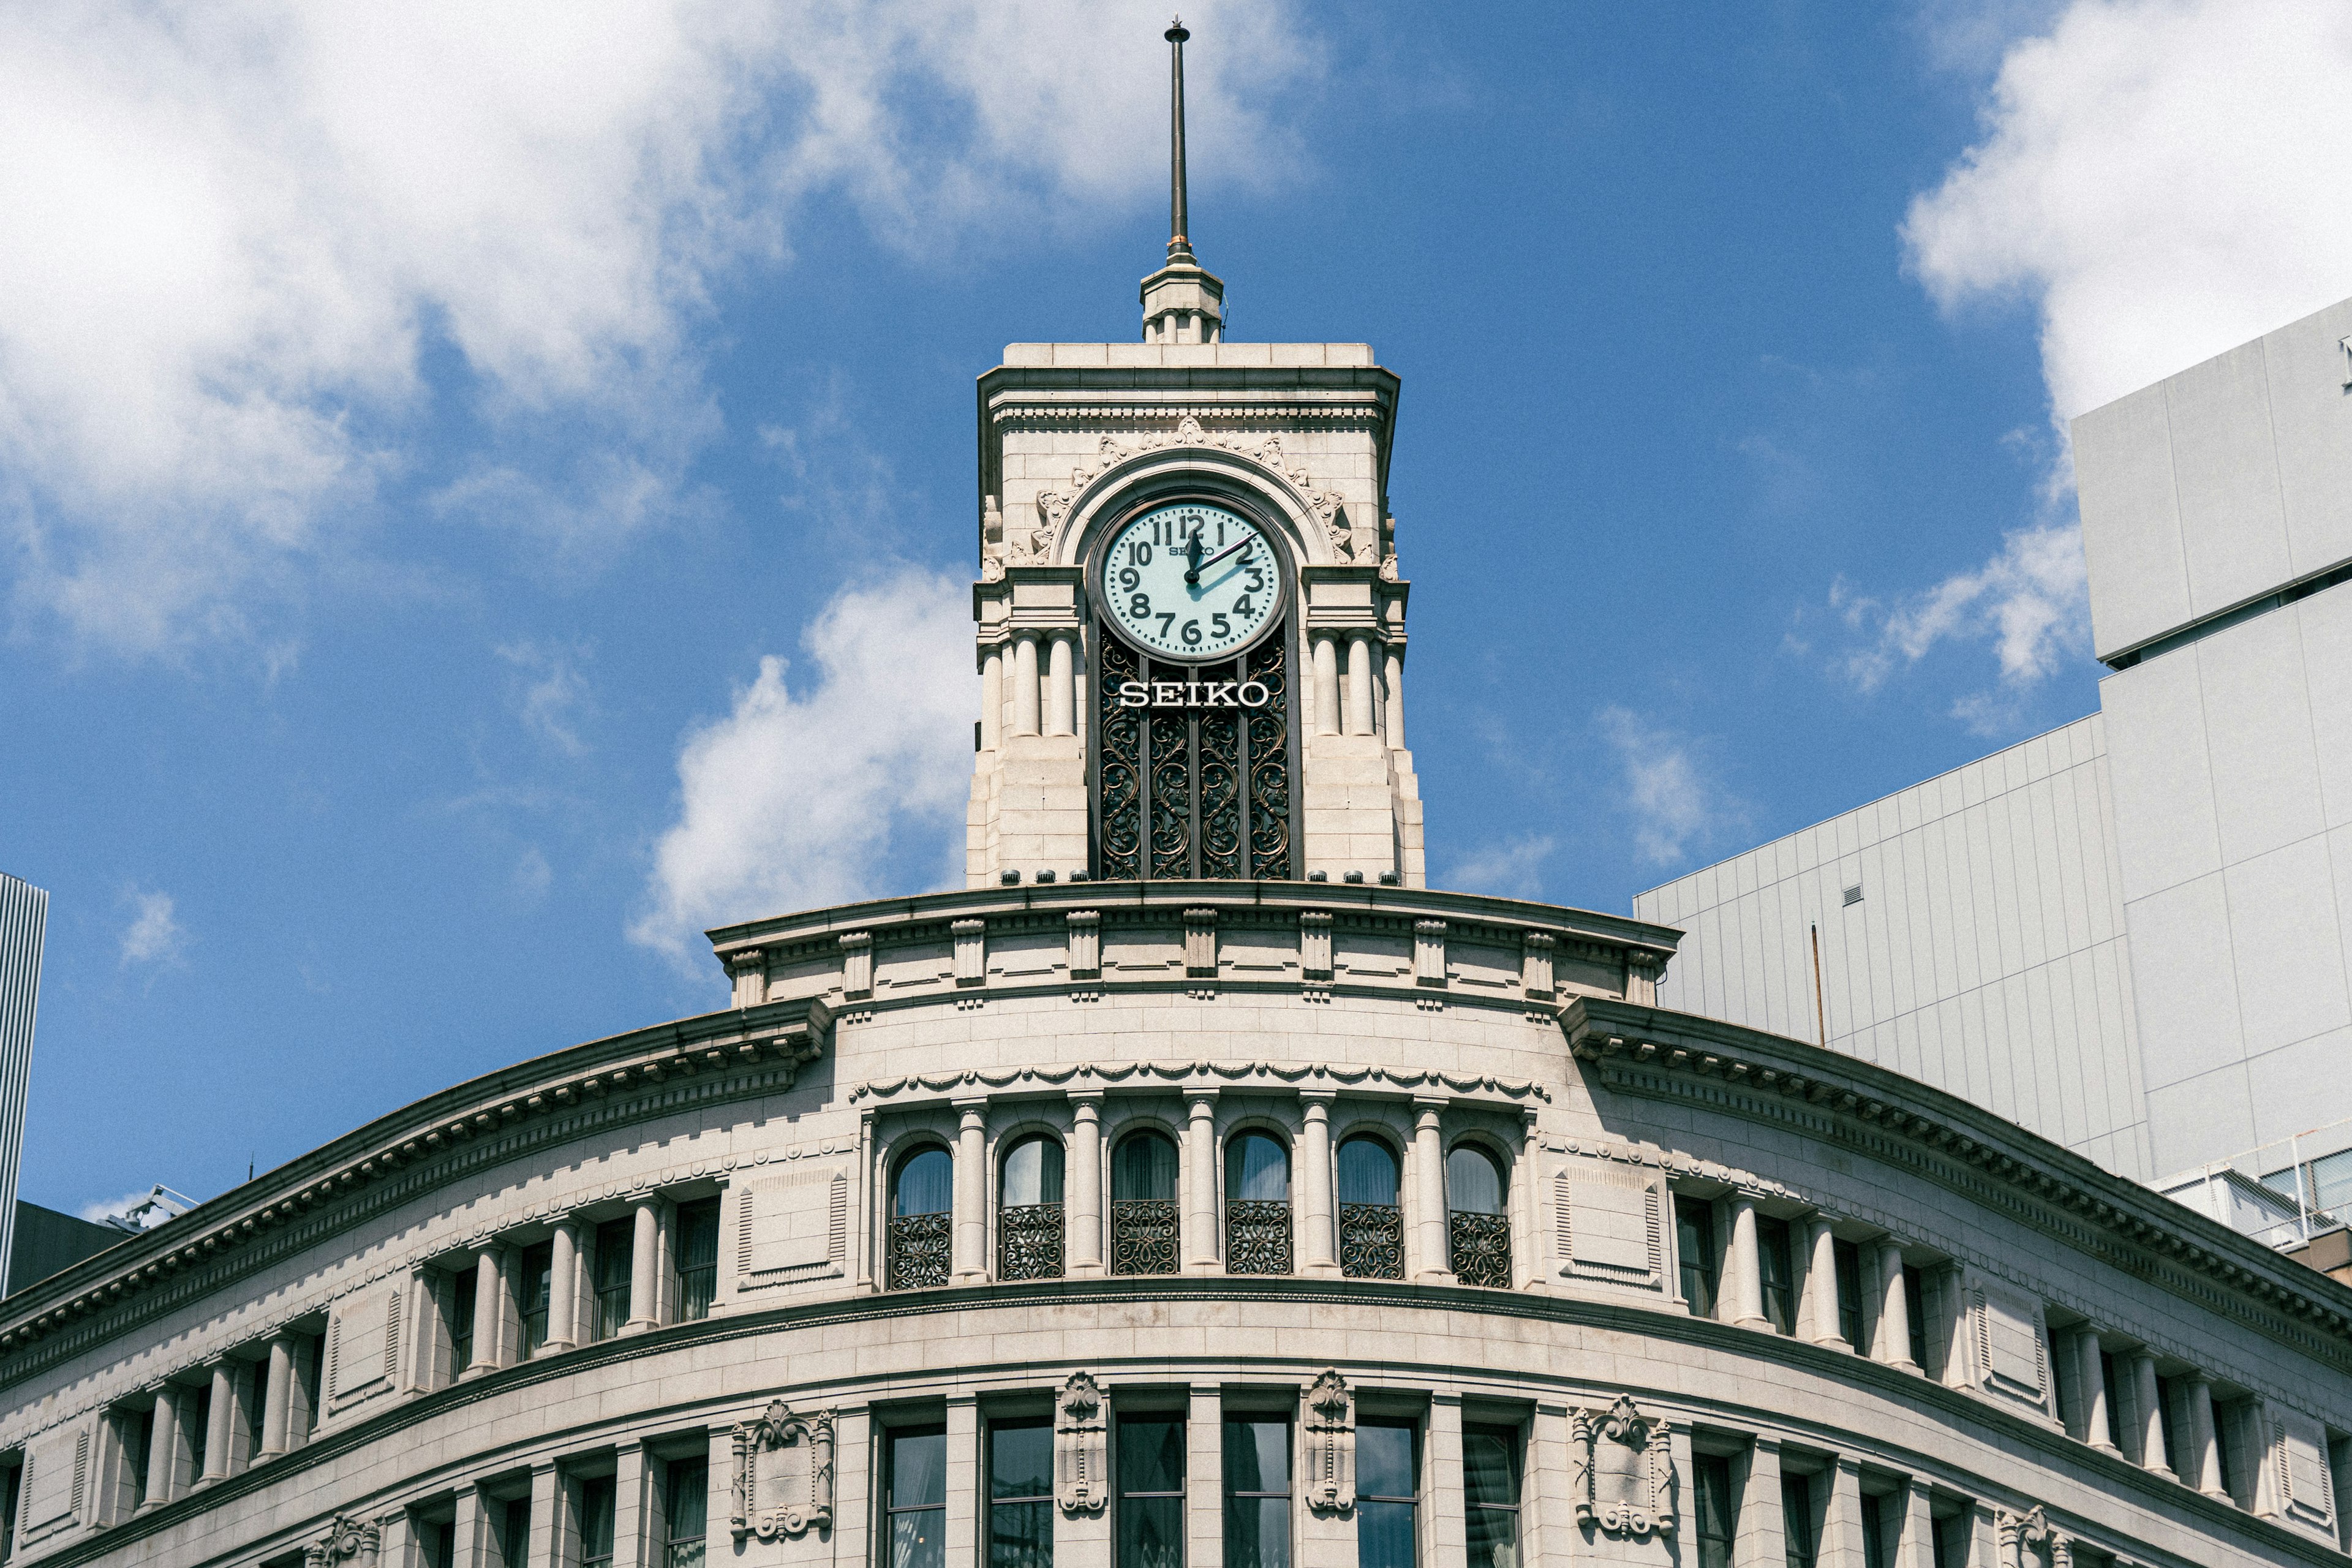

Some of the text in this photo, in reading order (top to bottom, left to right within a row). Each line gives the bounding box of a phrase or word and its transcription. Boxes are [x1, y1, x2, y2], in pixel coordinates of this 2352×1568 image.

[1153, 521, 1171, 546] 11
[1179, 514, 1205, 539] 12
[1217, 522, 1224, 546] 1
[1129, 541, 1152, 566] 10
[1169, 547, 1214, 556] SEO
[1235, 540, 1253, 564] 2
[1119, 567, 1140, 593] 9
[1244, 568, 1264, 593] 3
[1129, 593, 1151, 619] 8
[1232, 594, 1256, 619] 4
[1155, 612, 1175, 638] 7
[1181, 619, 1202, 645] 6
[1210, 613, 1231, 638] 5
[1120, 681, 1269, 707] SEIKO
